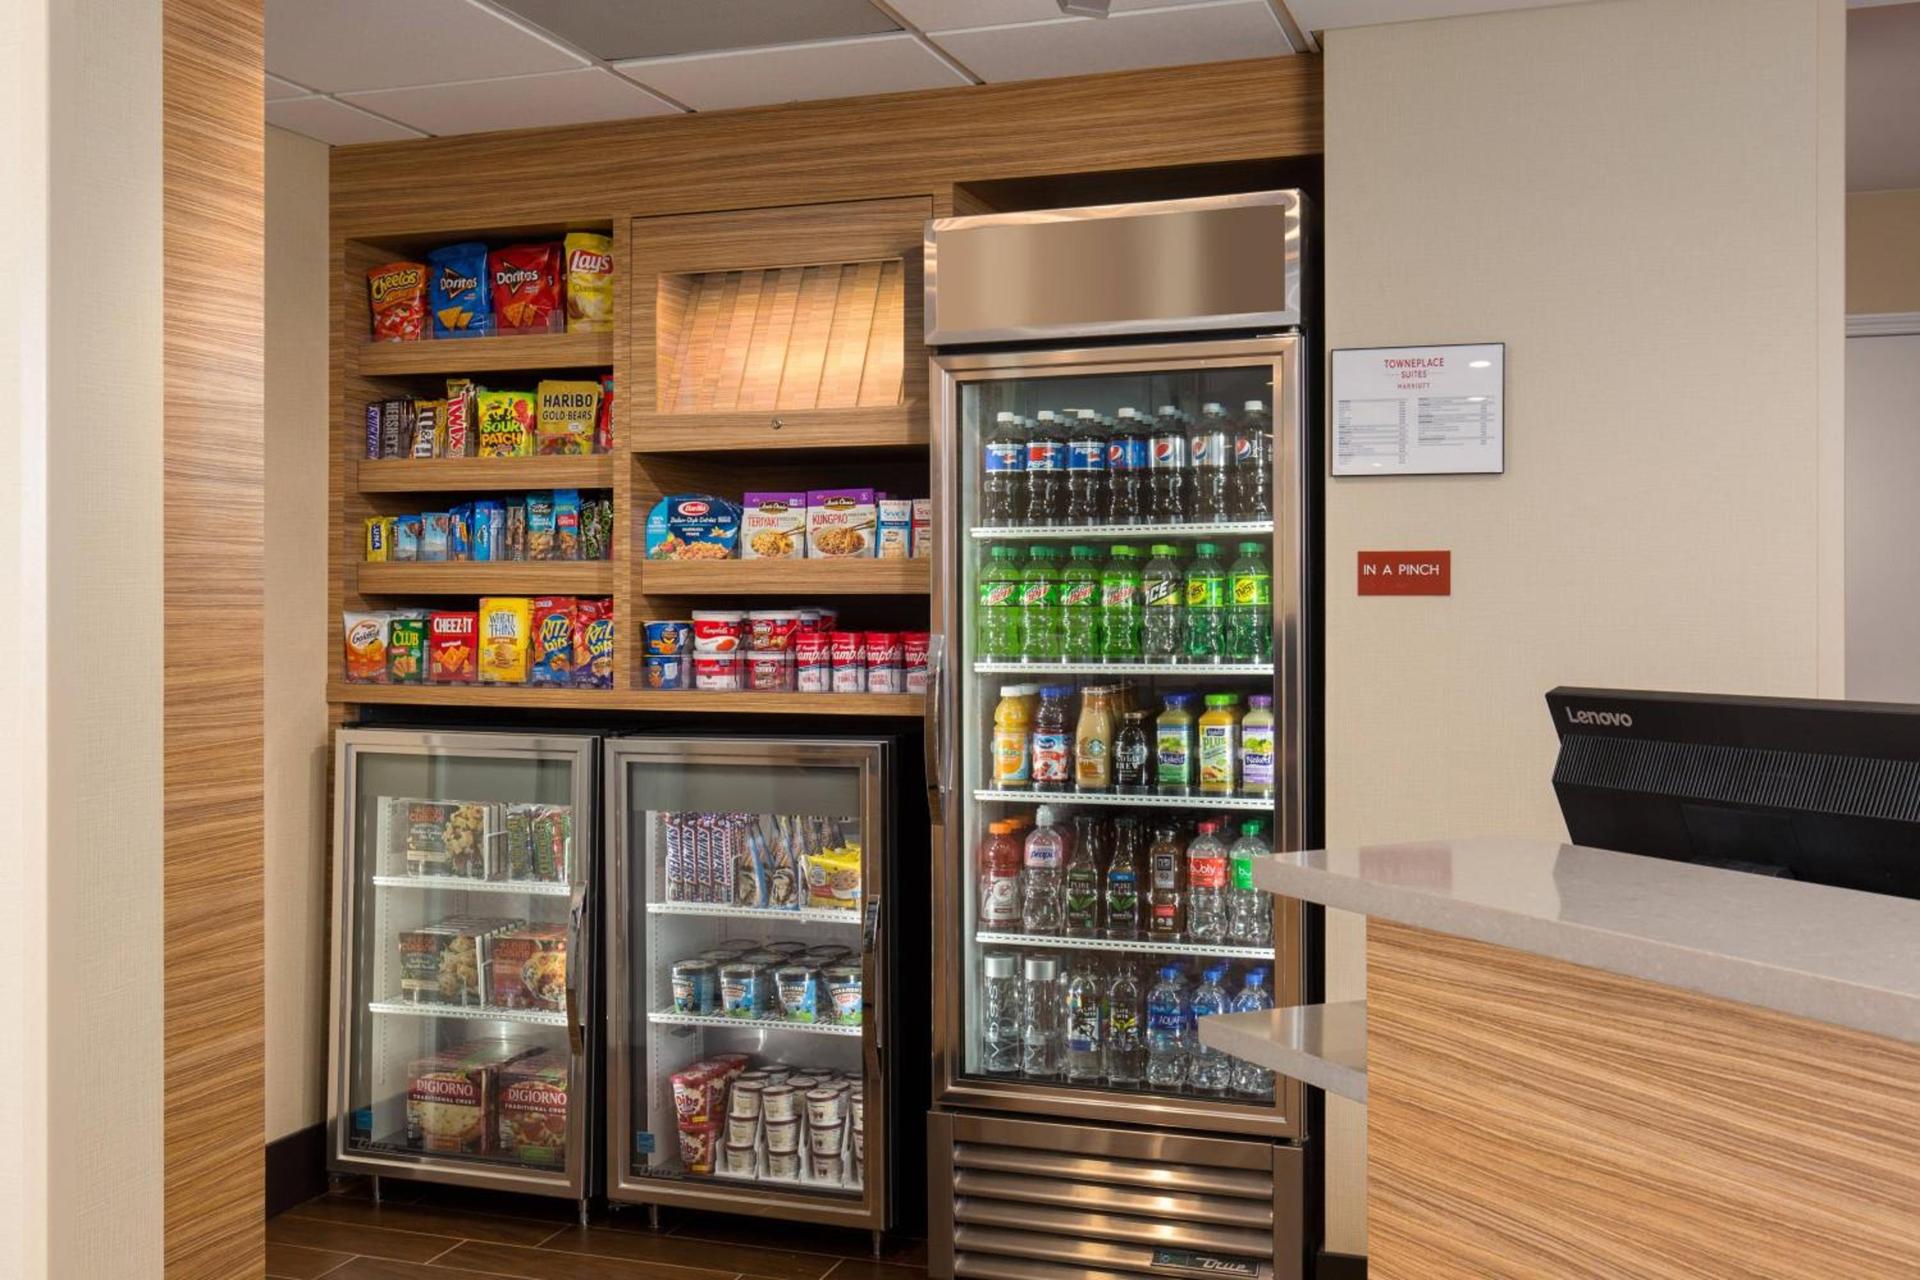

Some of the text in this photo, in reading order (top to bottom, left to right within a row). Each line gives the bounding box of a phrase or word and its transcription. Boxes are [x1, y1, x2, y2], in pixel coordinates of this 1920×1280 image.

[371, 269, 419, 299] Cheetos
[440, 276, 477, 290] Doritos
[496, 270, 539, 285] Doritos
[1384, 358, 1445, 369] TOWNEPLACE
[1401, 371, 1428, 379] SUITES
[543, 394, 593, 408] HARIBO
[447, 392, 466, 450] TWIX
[483, 420, 521, 432] SOUR
[482, 432, 522, 445] PATCH
[1363, 564, 1440, 576] IN A PINCH
[489, 612, 516, 623] WHEAT
[434, 617, 473, 633] CHEEZ-IT
[490, 623, 516, 637] THINS
[541, 619, 568, 640] RITZ
[392, 631, 419, 646] CLUB
[544, 638, 568, 652] bits
[1565, 706, 1633, 727] Lenovo
[416, 1079, 474, 1097] DIGIORNO
[413, 1093, 454, 1104] TRADITIONAL
[508, 1088, 568, 1105] DIGIORNO
[505, 1103, 547, 1113] TRADITIONAL
[1196, 1256, 1248, 1273] True
